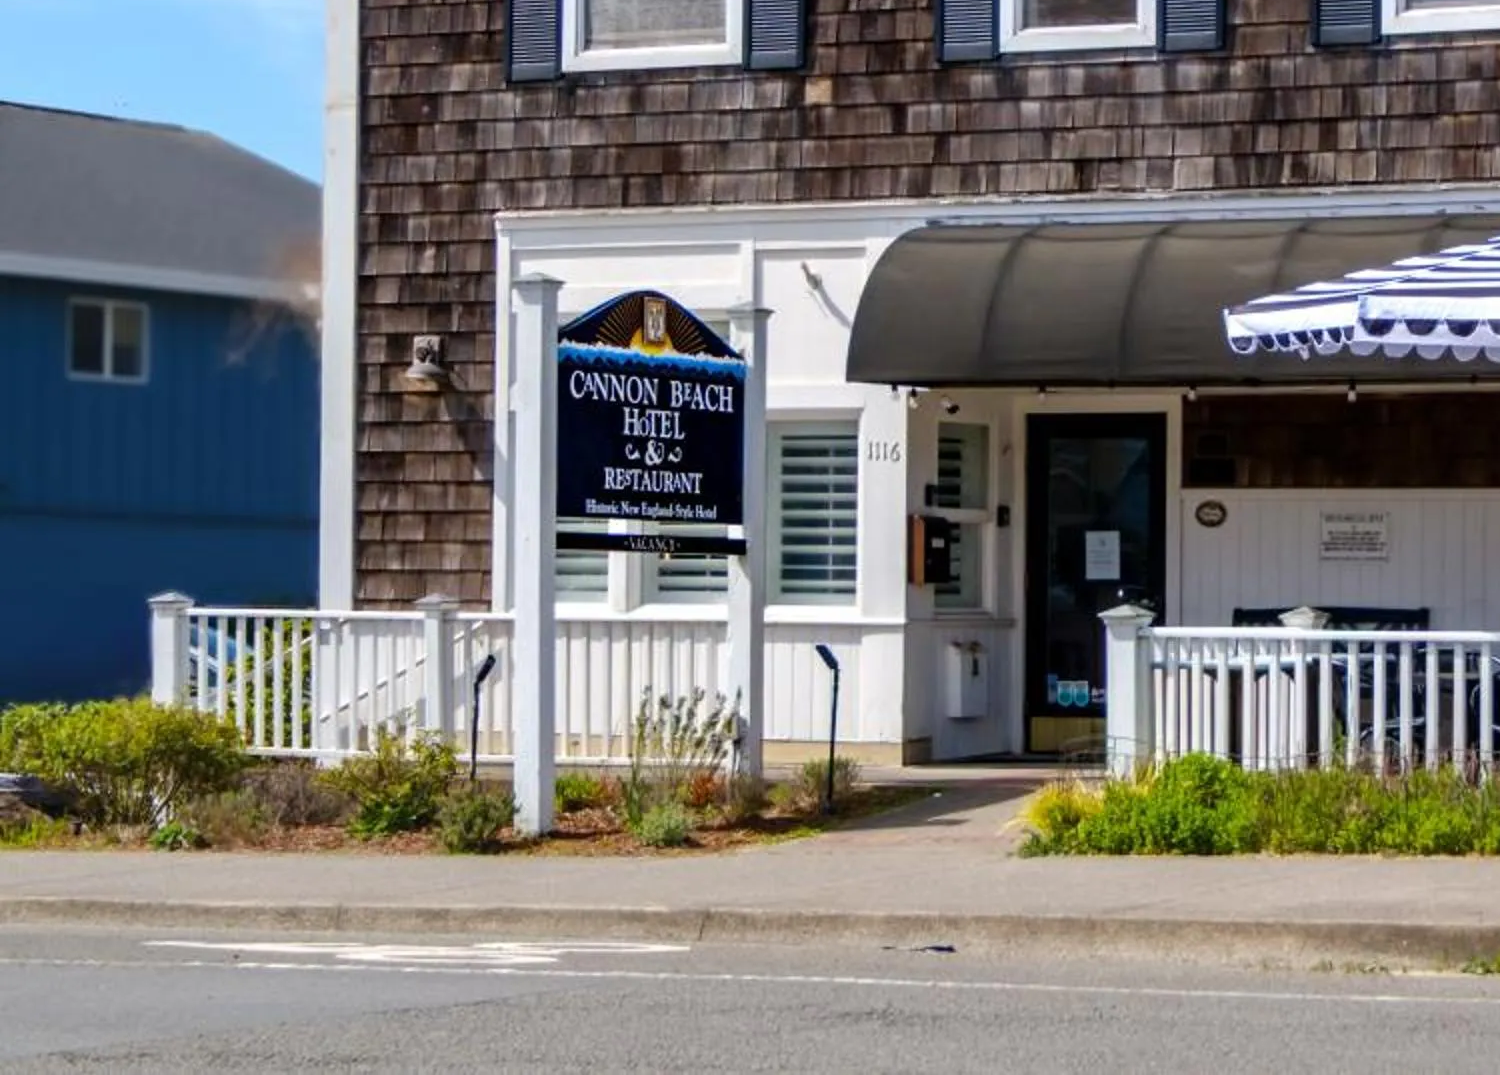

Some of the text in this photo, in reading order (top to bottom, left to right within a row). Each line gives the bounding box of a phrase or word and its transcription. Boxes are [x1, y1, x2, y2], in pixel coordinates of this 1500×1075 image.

[569, 370, 734, 413] CANNON BEACH
[622, 406, 685, 440] HOTEL
[644, 439, 665, 466] &
[868, 441, 901, 463] 1116
[604, 467, 703, 494] RESTAURANT
[586, 498, 619, 515] Historic
[621, 501, 640, 516] New
[695, 504, 717, 520] Hotel
[629, 536, 675, 551] VACANCY
